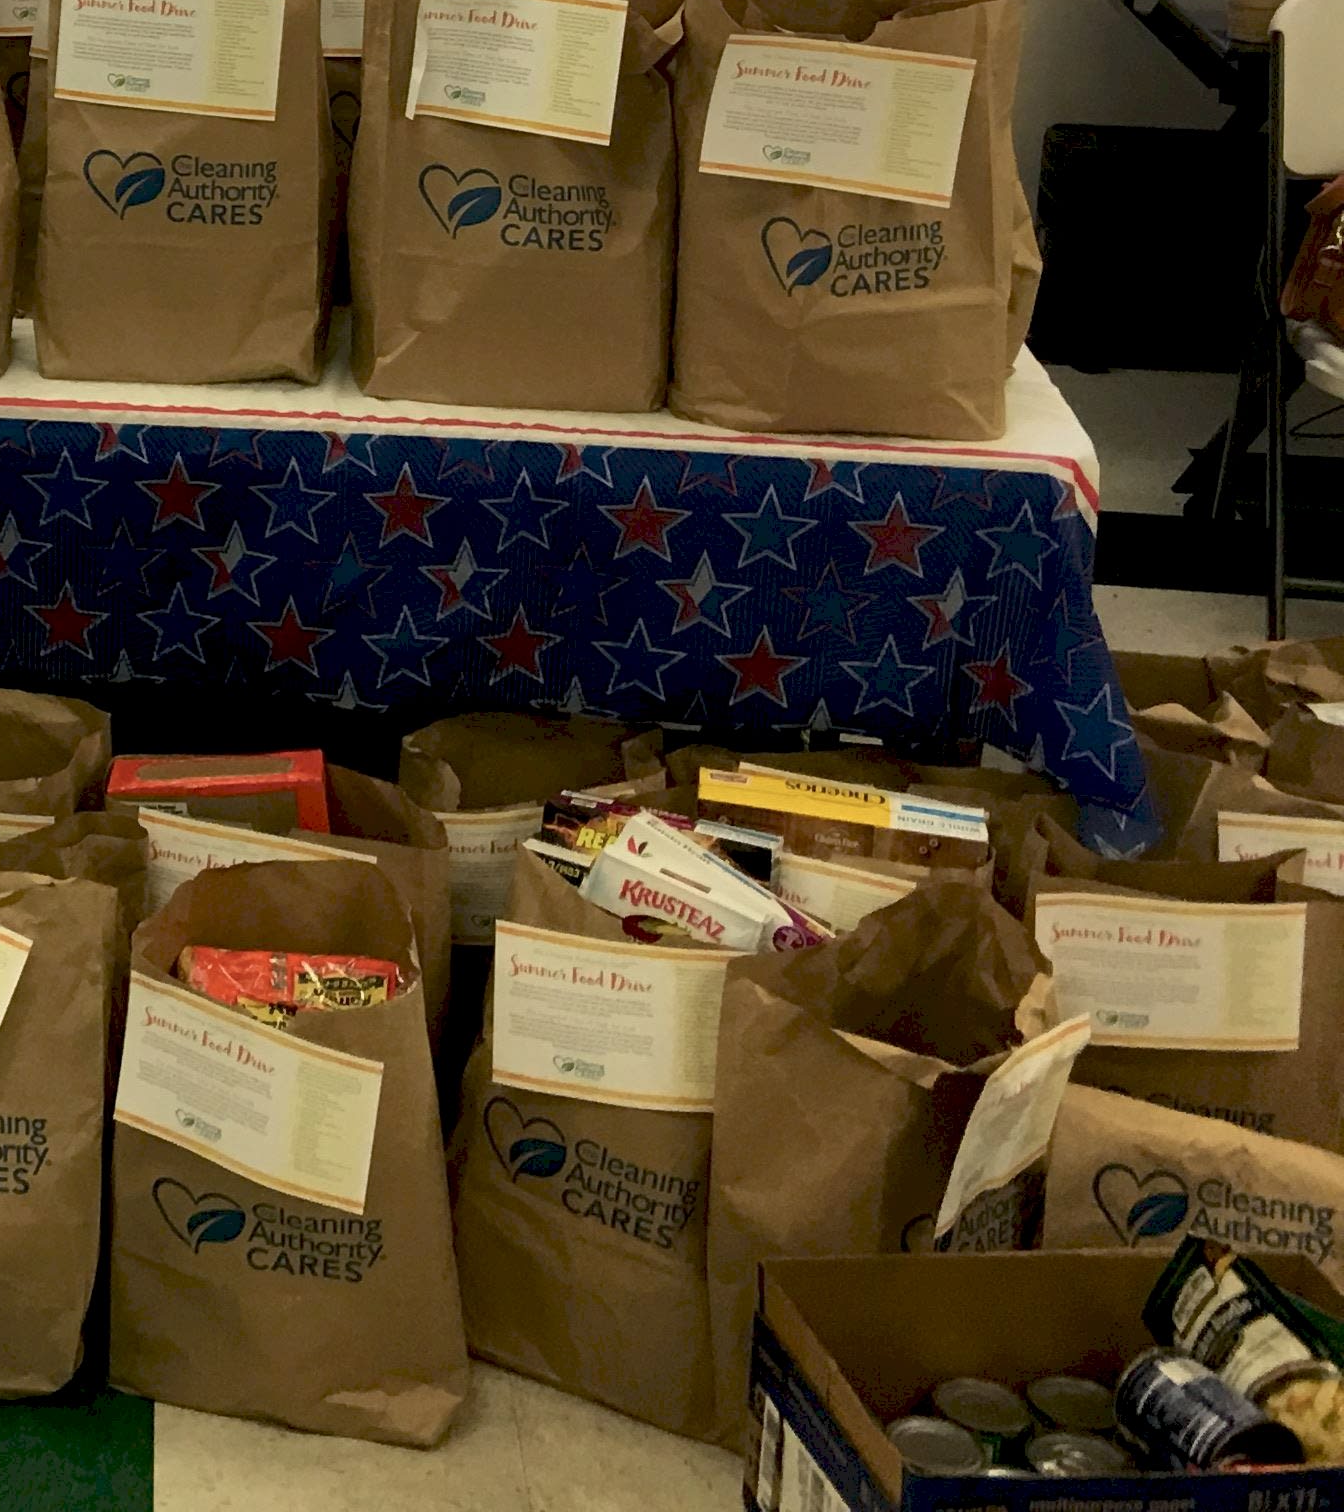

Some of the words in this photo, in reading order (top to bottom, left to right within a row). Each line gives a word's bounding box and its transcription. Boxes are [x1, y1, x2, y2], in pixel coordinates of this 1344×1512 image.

[160, 0, 197, 18] Drive
[467, 9, 496, 25] Food
[500, 10, 538, 31] Drive
[734, 59, 790, 79] Summer
[794, 66, 826, 82] Food
[830, 70, 871, 88] Drive
[171, 154, 278, 182] Cleaning
[167, 178, 278, 207] Authority
[508, 174, 610, 209] Cleaning
[167, 203, 263, 225] CARES
[501, 197, 612, 233] Authority
[500, 223, 603, 252] CARES
[837, 220, 944, 248] Cleaning
[833, 245, 945, 274] Authority
[830, 266, 930, 297] CARES
[784, 778, 886, 805] Cheerios
[618, 878, 726, 942] KRUSTEAZ
[509, 953, 566, 979] Summer
[571, 966, 604, 987] Food
[611, 971, 654, 992] Drive
[142, 1005, 198, 1042] Summer
[201, 1030, 232, 1056] Food
[236, 1044, 275, 1076] Drive
[574, 1138, 701, 1205] Cleaning
[564, 1162, 694, 1230] Authority
[1197, 1178, 1336, 1237] Cleaning
[252, 1202, 382, 1242] Cleaning
[561, 1189, 677, 1251] CARES
[247, 1222, 384, 1268] Authority
[1191, 1208, 1335, 1268] Authority
[246, 1247, 363, 1283] CARES
